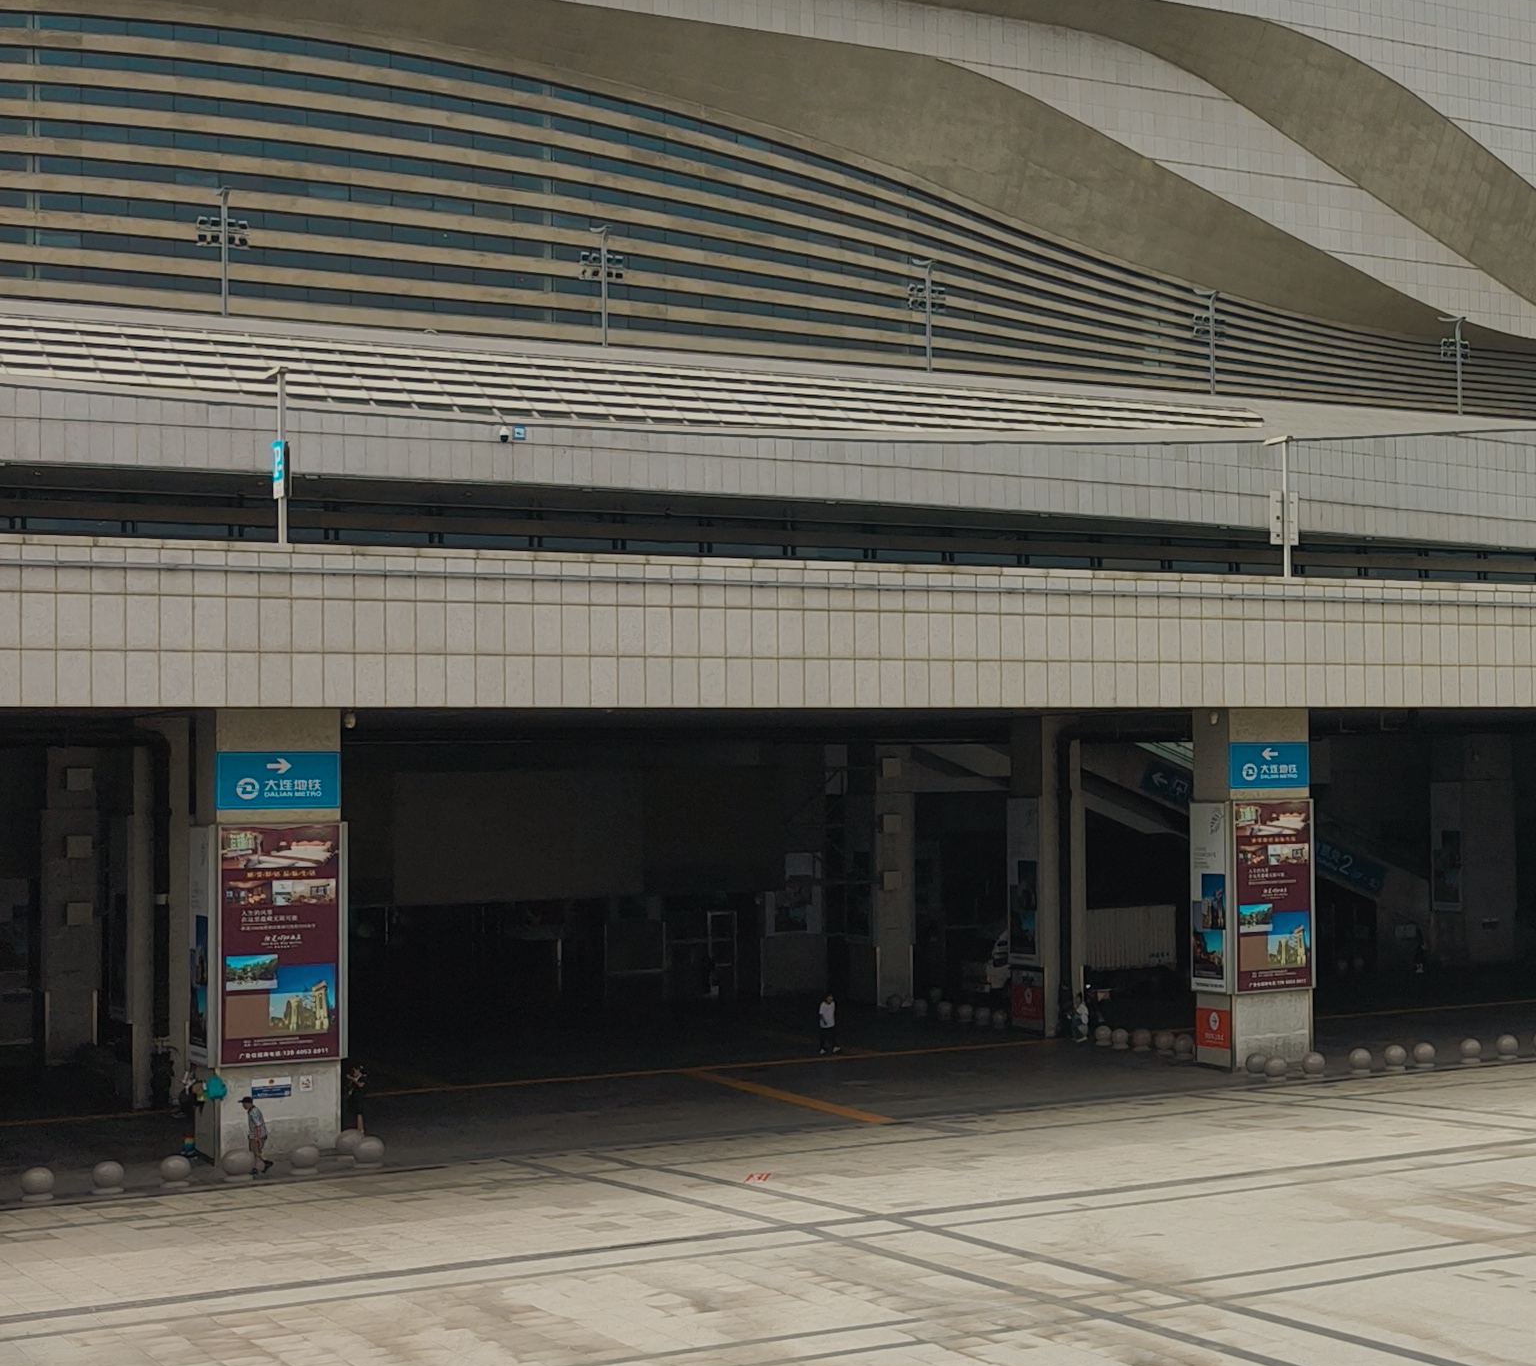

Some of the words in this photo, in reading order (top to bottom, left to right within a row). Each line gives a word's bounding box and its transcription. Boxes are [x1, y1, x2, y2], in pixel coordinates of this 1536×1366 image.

[263, 779, 322, 791] 大连地铁
[294, 790, 322, 798] METRO
